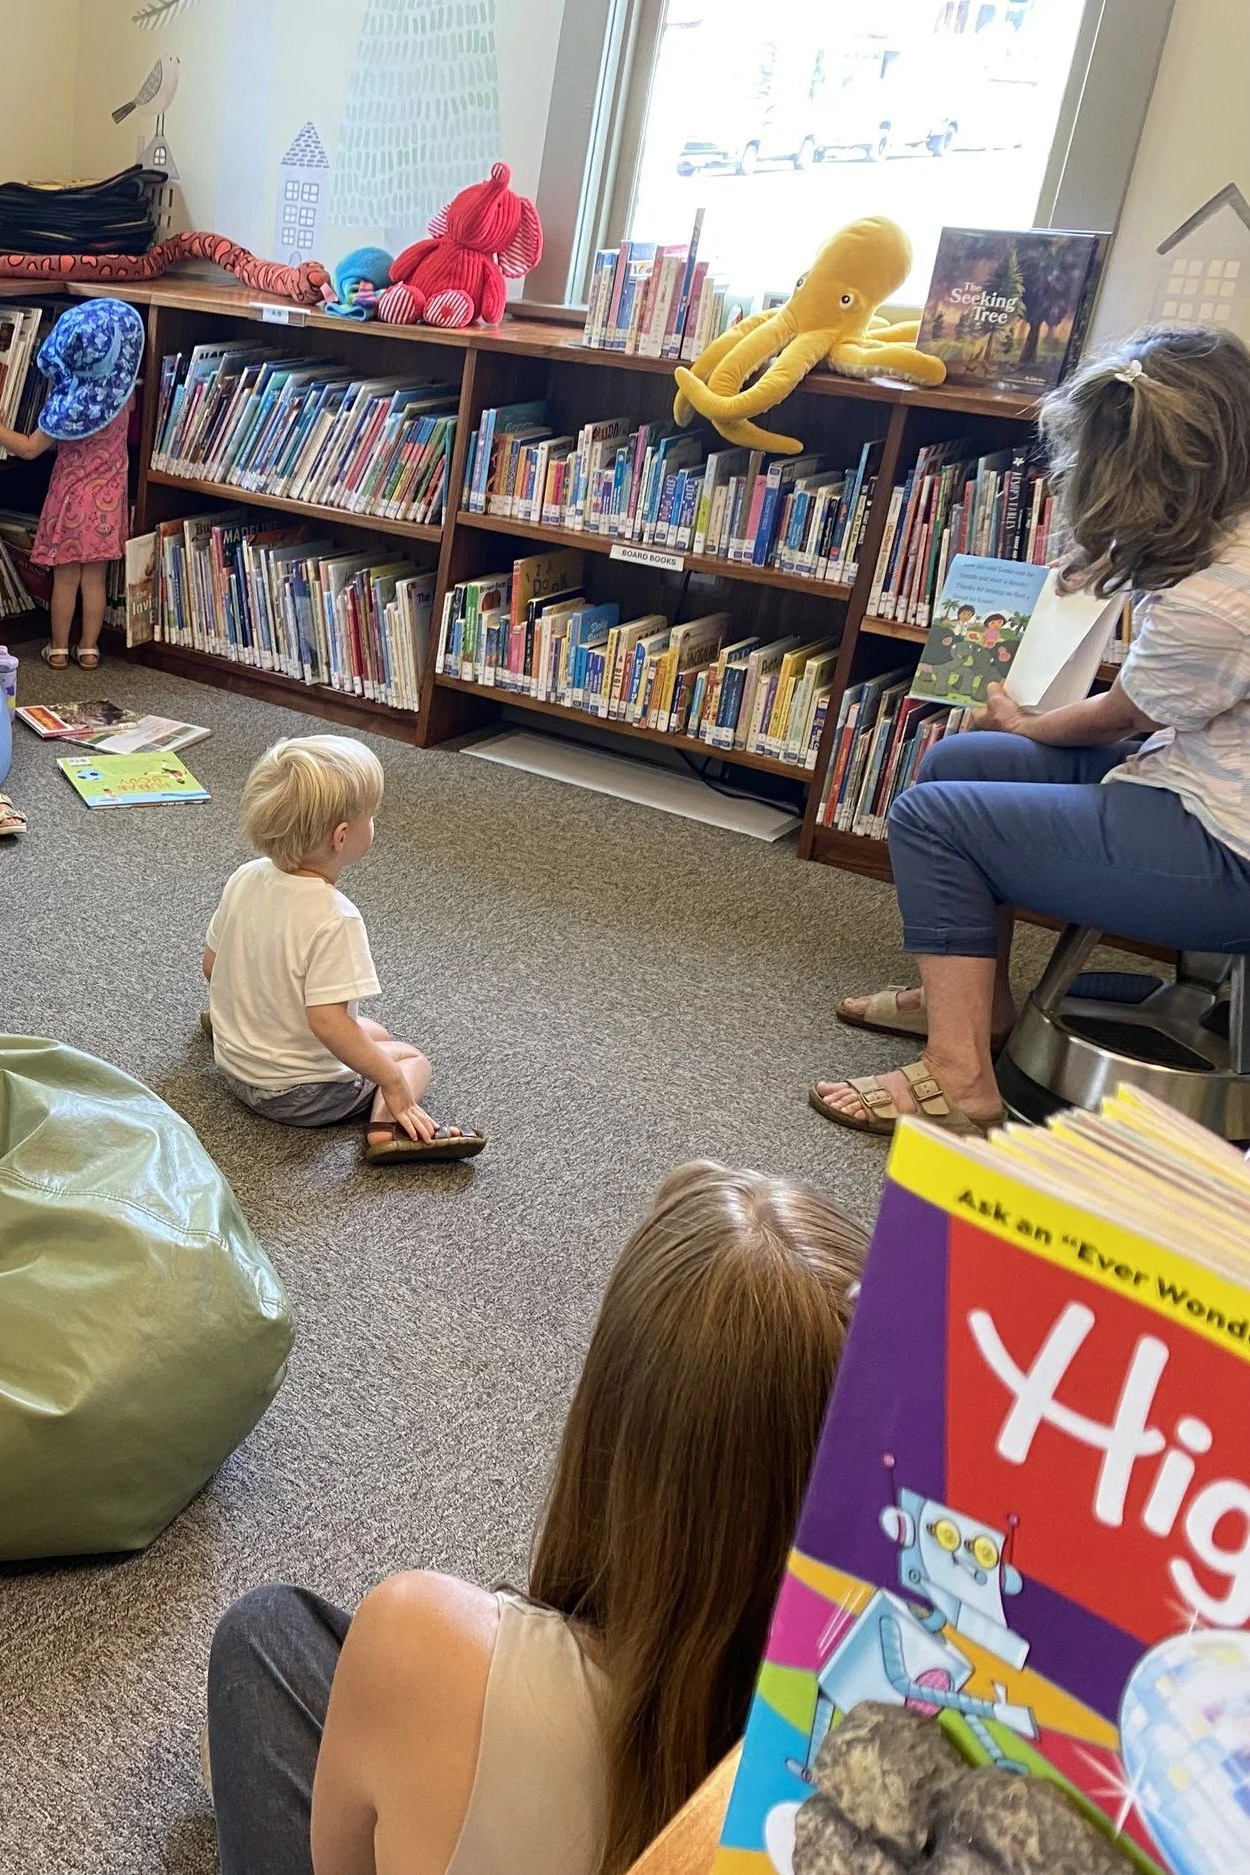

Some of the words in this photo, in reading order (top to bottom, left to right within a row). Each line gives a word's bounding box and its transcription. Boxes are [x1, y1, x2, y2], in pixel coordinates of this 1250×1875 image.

[964, 281, 982, 292] The
[950, 287, 1018, 313] Seeking
[972, 305, 1008, 324] Tree
[223, 520, 278, 545] MADELINE
[622, 549, 648, 560] BOARD
[650, 554, 676, 566] BOOKS
[957, 1189, 1008, 1226] Ask
[1016, 1218, 1053, 1246] an
[1157, 1275, 1250, 1343] Wond
